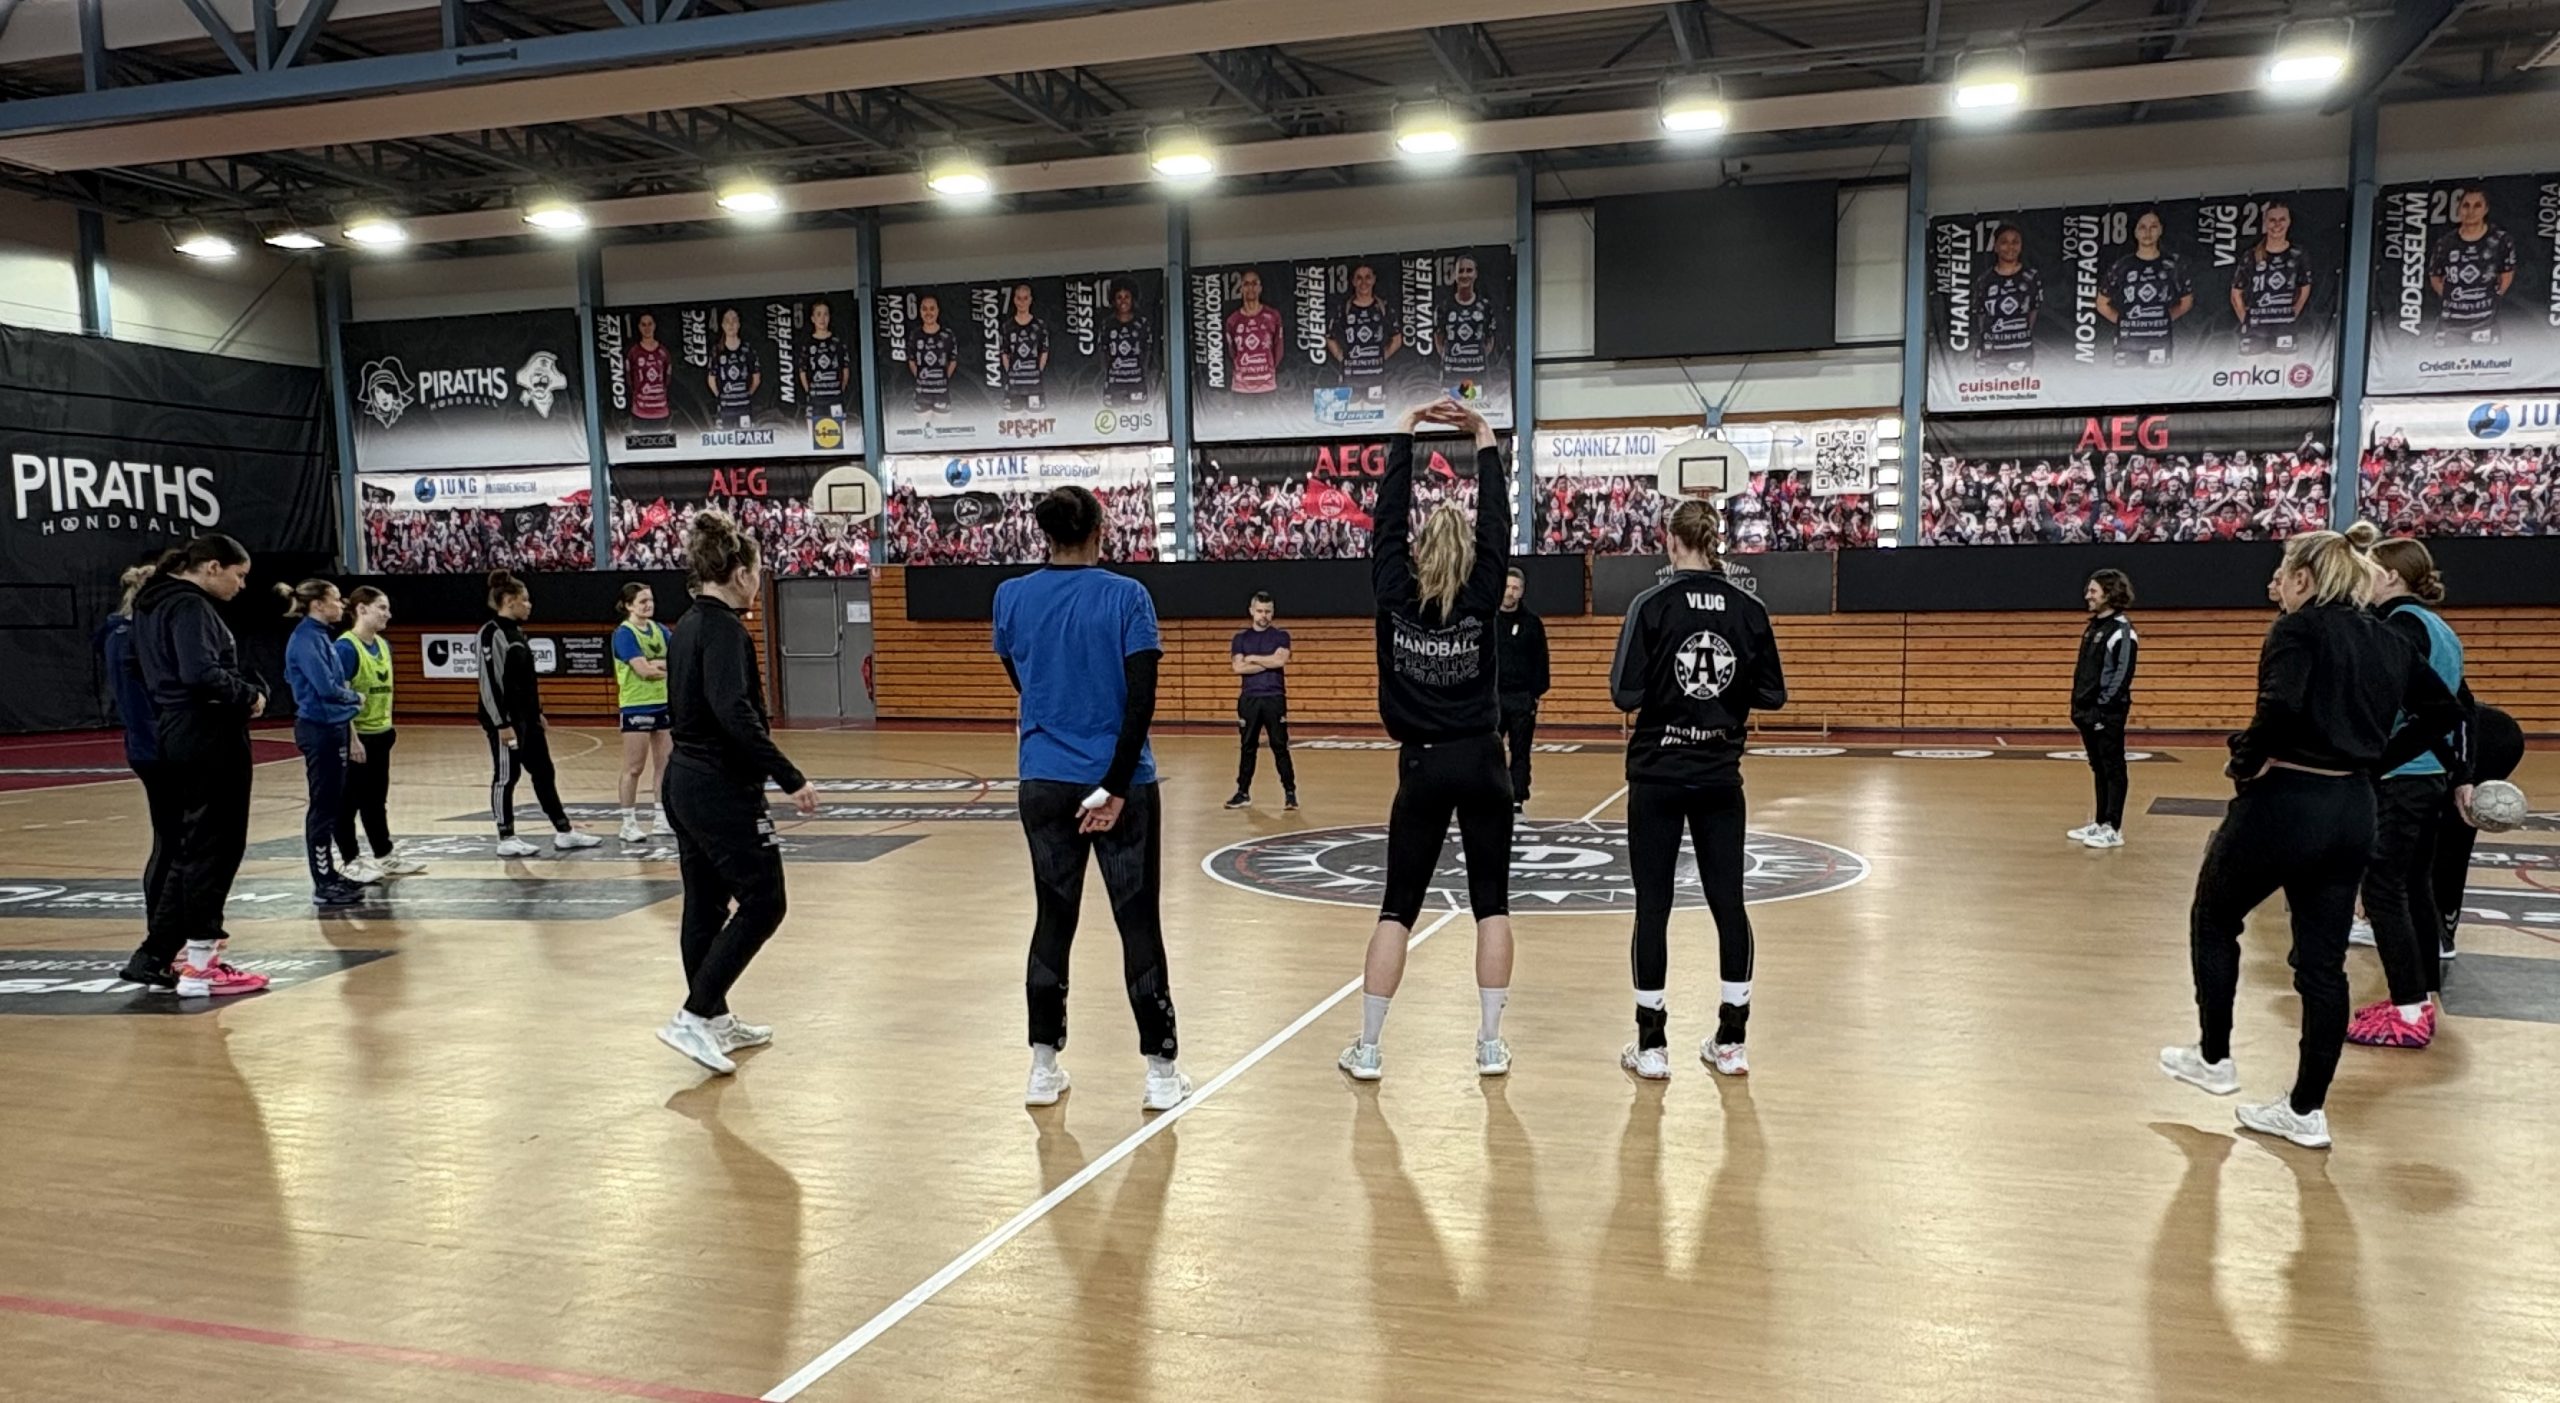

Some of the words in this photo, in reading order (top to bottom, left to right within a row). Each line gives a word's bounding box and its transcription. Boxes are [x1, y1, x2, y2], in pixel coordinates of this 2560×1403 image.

[2101, 211, 2128, 245] 18
[2198, 205, 2215, 244] LISA
[2385, 193, 2403, 259] DALILA
[2538, 183, 2559, 238] NORA
[1974, 220, 2001, 252] 17
[2062, 215, 2079, 262] YOSR
[2213, 205, 2238, 267] VLUG
[1434, 256, 1456, 286] 15
[1934, 223, 1952, 294] MÉLISSA
[2400, 191, 2428, 336] ABDESSELAM
[1222, 271, 1243, 301] 12
[1328, 265, 1348, 295] 13
[1950, 223, 1971, 351] CHANTELLY
[2075, 215, 2100, 364] MOSTEFAOUI
[877, 294, 891, 338] LILOU
[906, 292, 918, 321] 6
[971, 289, 983, 321] ELIN
[1001, 287, 1013, 315] 7
[1066, 281, 1079, 334] LOUISE
[1078, 281, 1094, 355] CUSSET
[1191, 274, 1207, 365] ELIHANNAH
[1294, 266, 1311, 350] CHARLÈNE
[1308, 265, 1327, 365] GUERRIER
[1402, 259, 1416, 347] CORENTINE
[1415, 257, 1433, 356] CAVALIER
[682, 310, 694, 364] AGATHE
[692, 309, 707, 367] CLERC
[766, 303, 779, 341] JULIA
[888, 294, 907, 361] BEGON
[983, 288, 1002, 388] KARLSSON
[607, 313, 627, 410] GONZALEZ
[777, 303, 796, 403] MAUFFREY
[2418, 361, 2456, 372] Crédit
[2470, 358, 2513, 370] Mutuel
[418, 366, 509, 404] PIRATHS
[1958, 376, 2041, 394] cuisinella
[2212, 364, 2281, 386] emka
[1119, 413, 1153, 432] egis
[2075, 415, 2169, 452] AEG
[1313, 444, 1386, 477] AEG
[1552, 437, 1622, 458] SCANNEZ
[1625, 435, 1656, 456] MOI
[440, 477, 478, 495] JUNG
[708, 467, 768, 497] AEG
[976, 456, 1029, 477] STANE
[11, 454, 221, 528] PIRATHS
[1686, 591, 1726, 611] VLUG
[1393, 631, 1480, 657] HANDBALL
[1688, 647, 1719, 685] A
